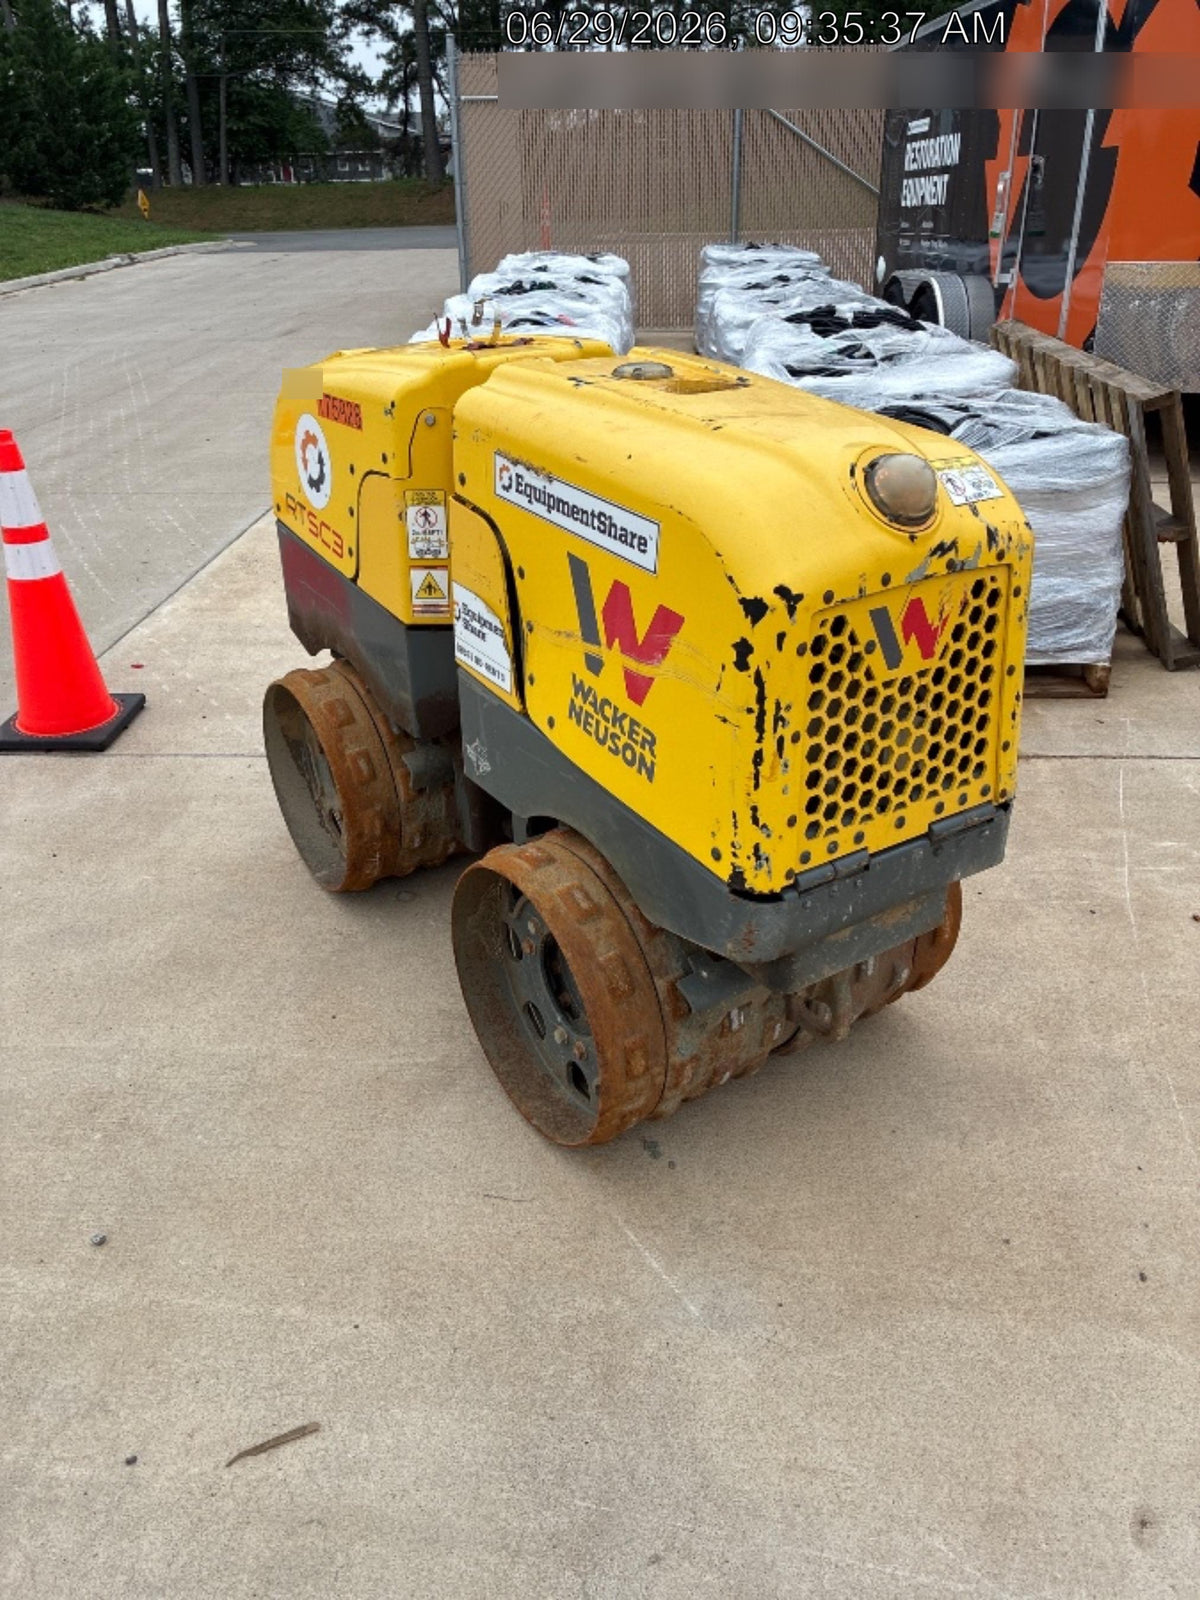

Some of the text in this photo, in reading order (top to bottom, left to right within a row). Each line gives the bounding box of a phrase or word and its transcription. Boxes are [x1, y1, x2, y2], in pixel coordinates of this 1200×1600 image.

[904, 132, 961, 171] RESTORATION
[901, 173, 950, 208] EQUIPMENT
[285, 492, 344, 559] RTSC3
[515, 472, 648, 554] EquipmentShare
[568, 697, 656, 784] NEUSON
[571, 672, 657, 759] WACKER
